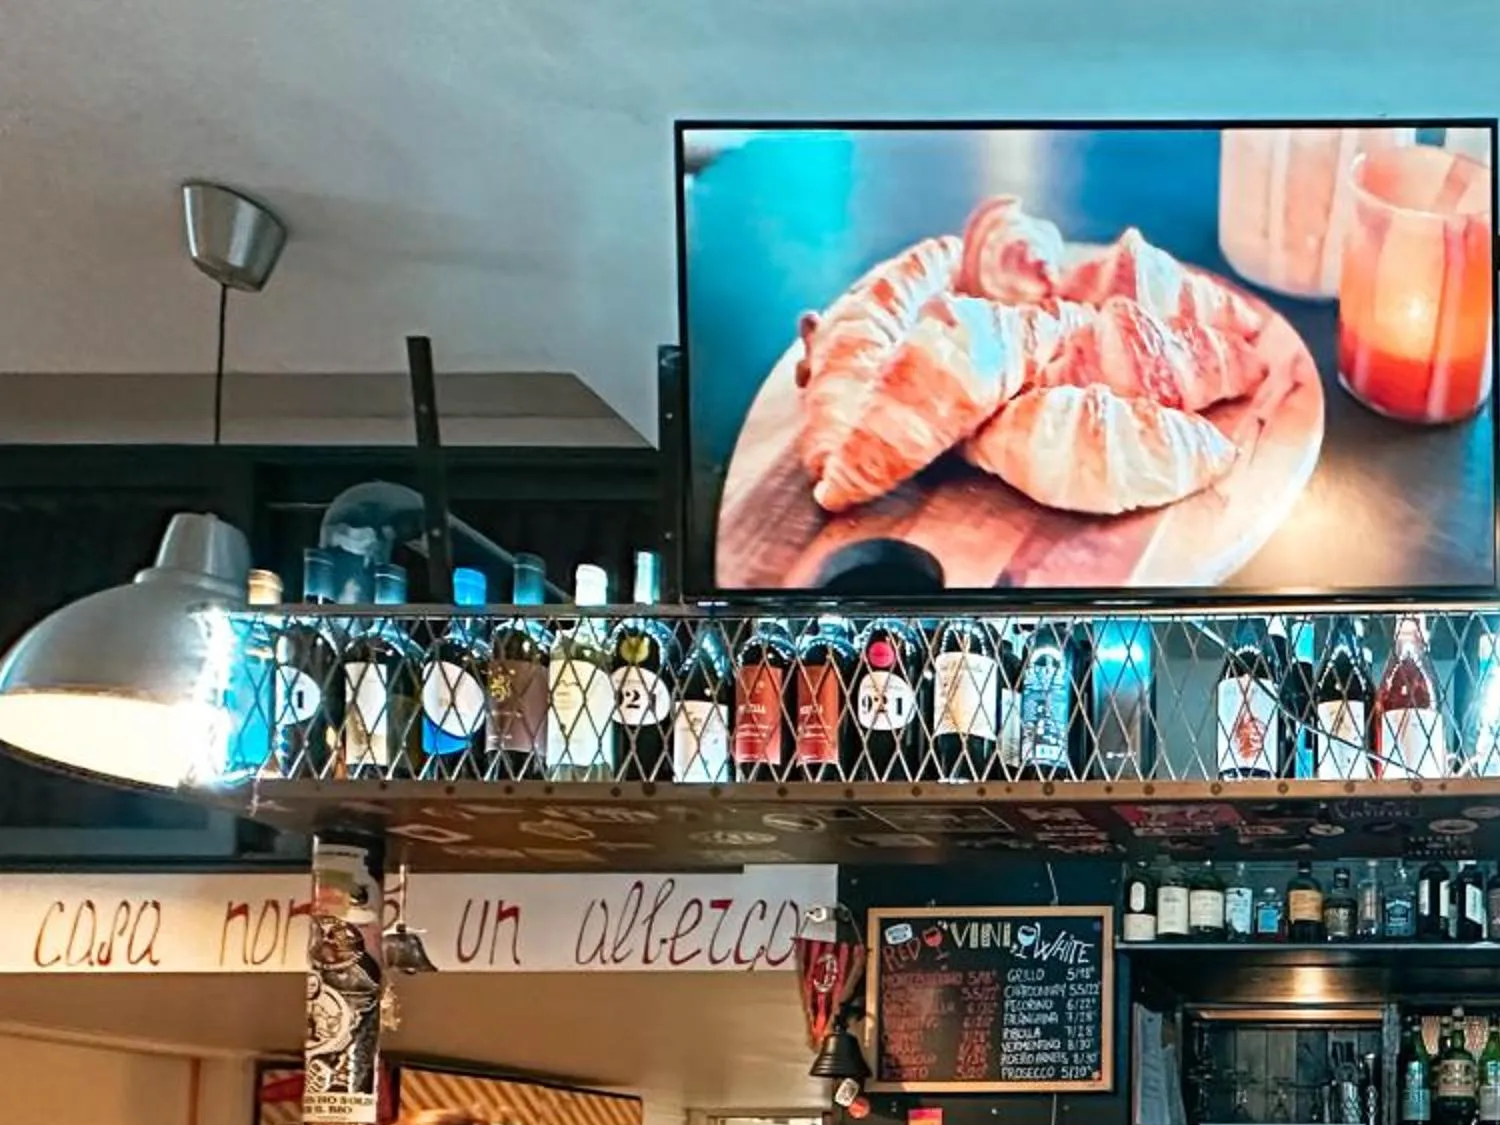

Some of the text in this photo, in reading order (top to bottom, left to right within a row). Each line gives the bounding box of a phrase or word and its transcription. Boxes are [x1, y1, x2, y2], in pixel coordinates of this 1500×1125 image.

[34, 899, 161, 967] casa
[457, 898, 521, 966] un
[951, 921, 1012, 949] VINI
